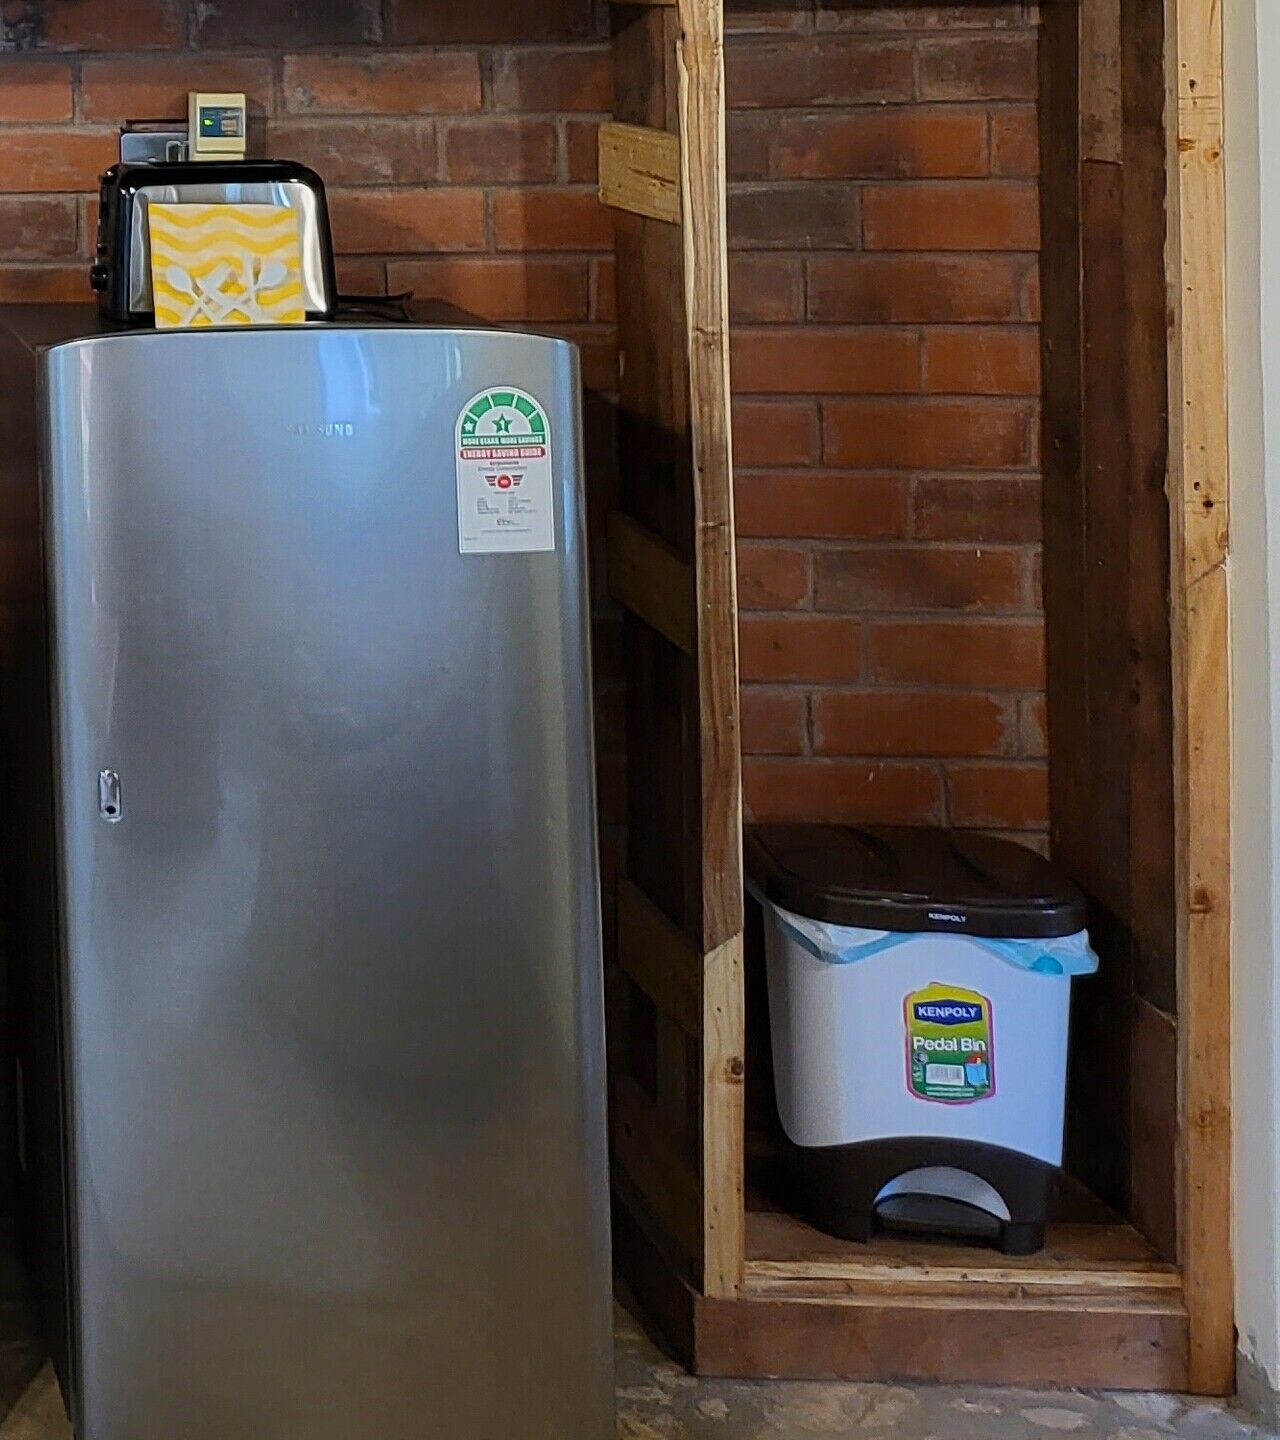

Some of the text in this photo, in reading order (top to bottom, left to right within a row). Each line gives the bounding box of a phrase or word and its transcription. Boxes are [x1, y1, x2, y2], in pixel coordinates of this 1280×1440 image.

[463, 449, 491, 458] ENERGY
[918, 1006, 977, 1018] KENPOLY
[913, 1036, 986, 1052] Pedal Bin
